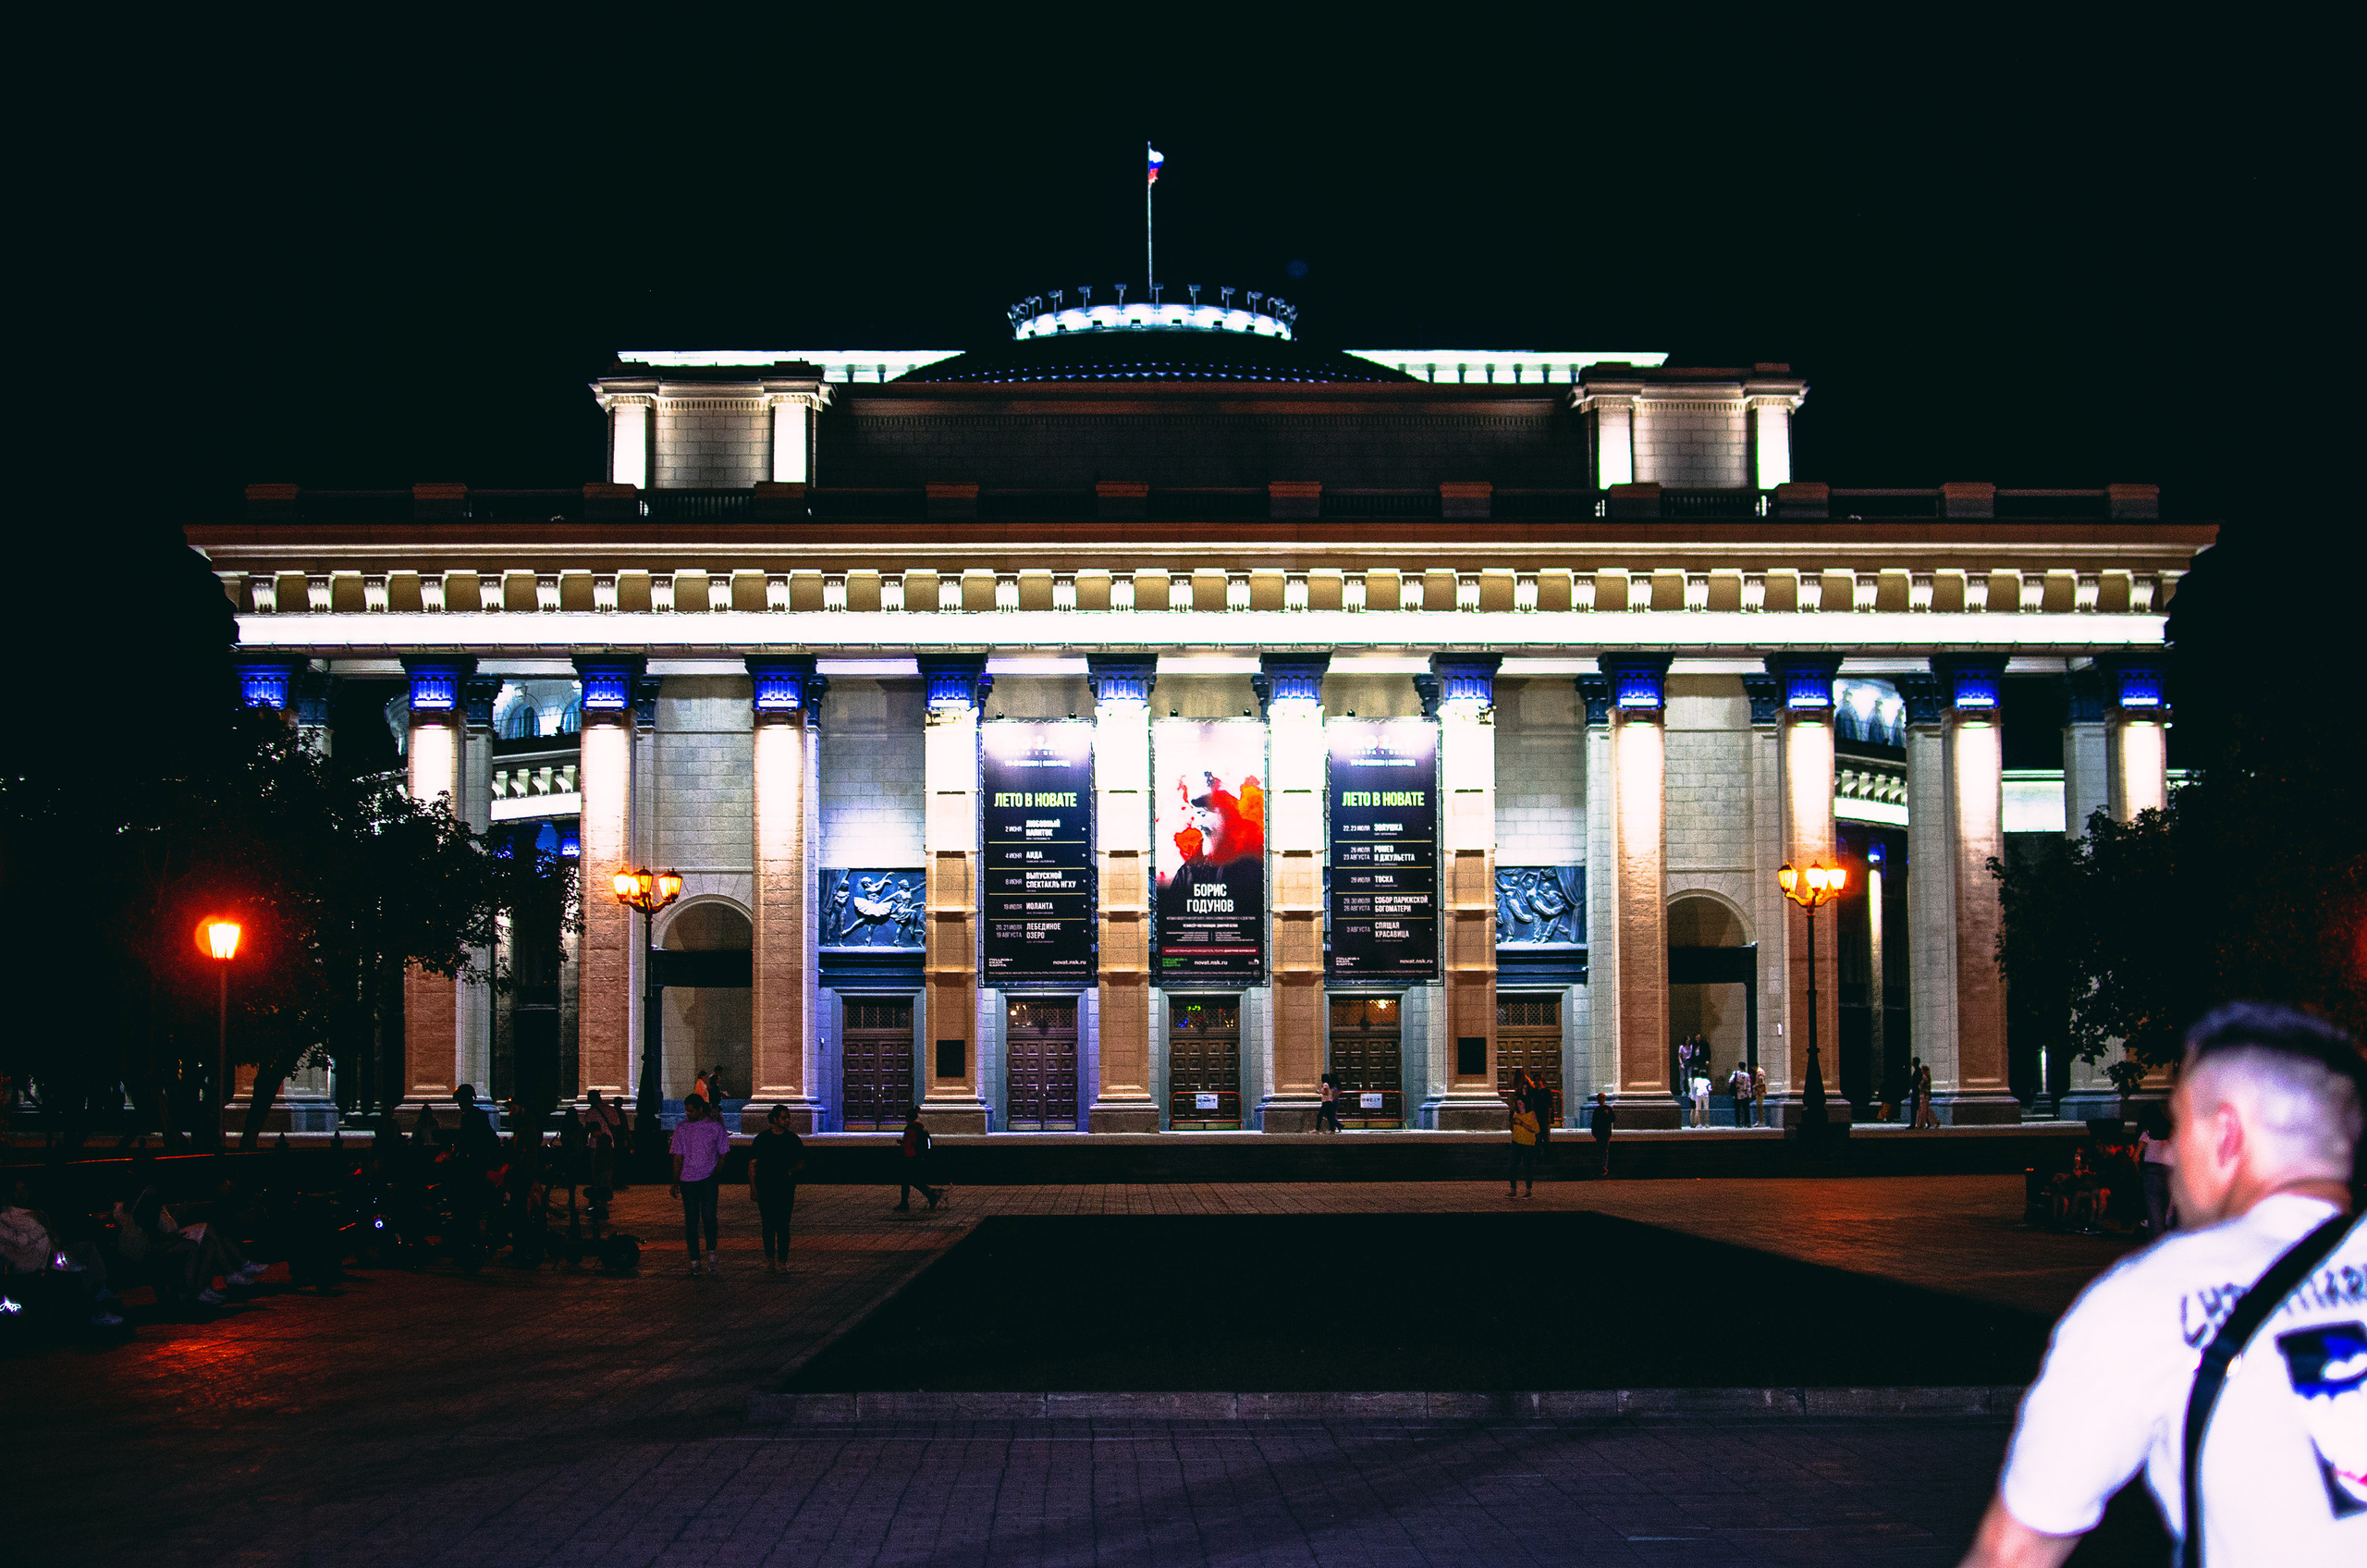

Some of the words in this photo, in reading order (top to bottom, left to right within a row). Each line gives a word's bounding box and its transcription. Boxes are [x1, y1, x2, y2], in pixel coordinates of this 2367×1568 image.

[994, 792, 1023, 807] ЛЕТО
[1024, 792, 1033, 807] В
[1035, 792, 1077, 807] НОВАТЕ
[1342, 791, 1370, 806] ЛЕТО
[1372, 791, 1380, 806] В
[1382, 791, 1425, 806] НОВАТЕ
[1374, 845, 1394, 853] РОМЕО
[1025, 851, 1043, 860] АИДА
[1374, 853, 1379, 862] И
[1380, 853, 1416, 862] ДЖУЛЬЕТТА
[1025, 871, 1062, 880] ВЫПУСКНОЙ
[1374, 875, 1394, 883] ТОСКА
[1025, 880, 1060, 888] СПЕКТАКЛЬ
[1061, 880, 1076, 888] НГХУ
[1194, 883, 1227, 897] БОРИС
[1374, 896, 1393, 904] СОБОР
[1393, 894, 1429, 904] ПАРИЖСКОЙ
[1186, 900, 1234, 913] ГОДУНОВ
[1026, 923, 1061, 931] ЛЕБЕДИНОЕ
[1375, 922, 1400, 930] СПЯЩАЯ
[1026, 931, 1045, 939] ОЗЕРО
[1375, 930, 1410, 938] КРАСАВИЦА
